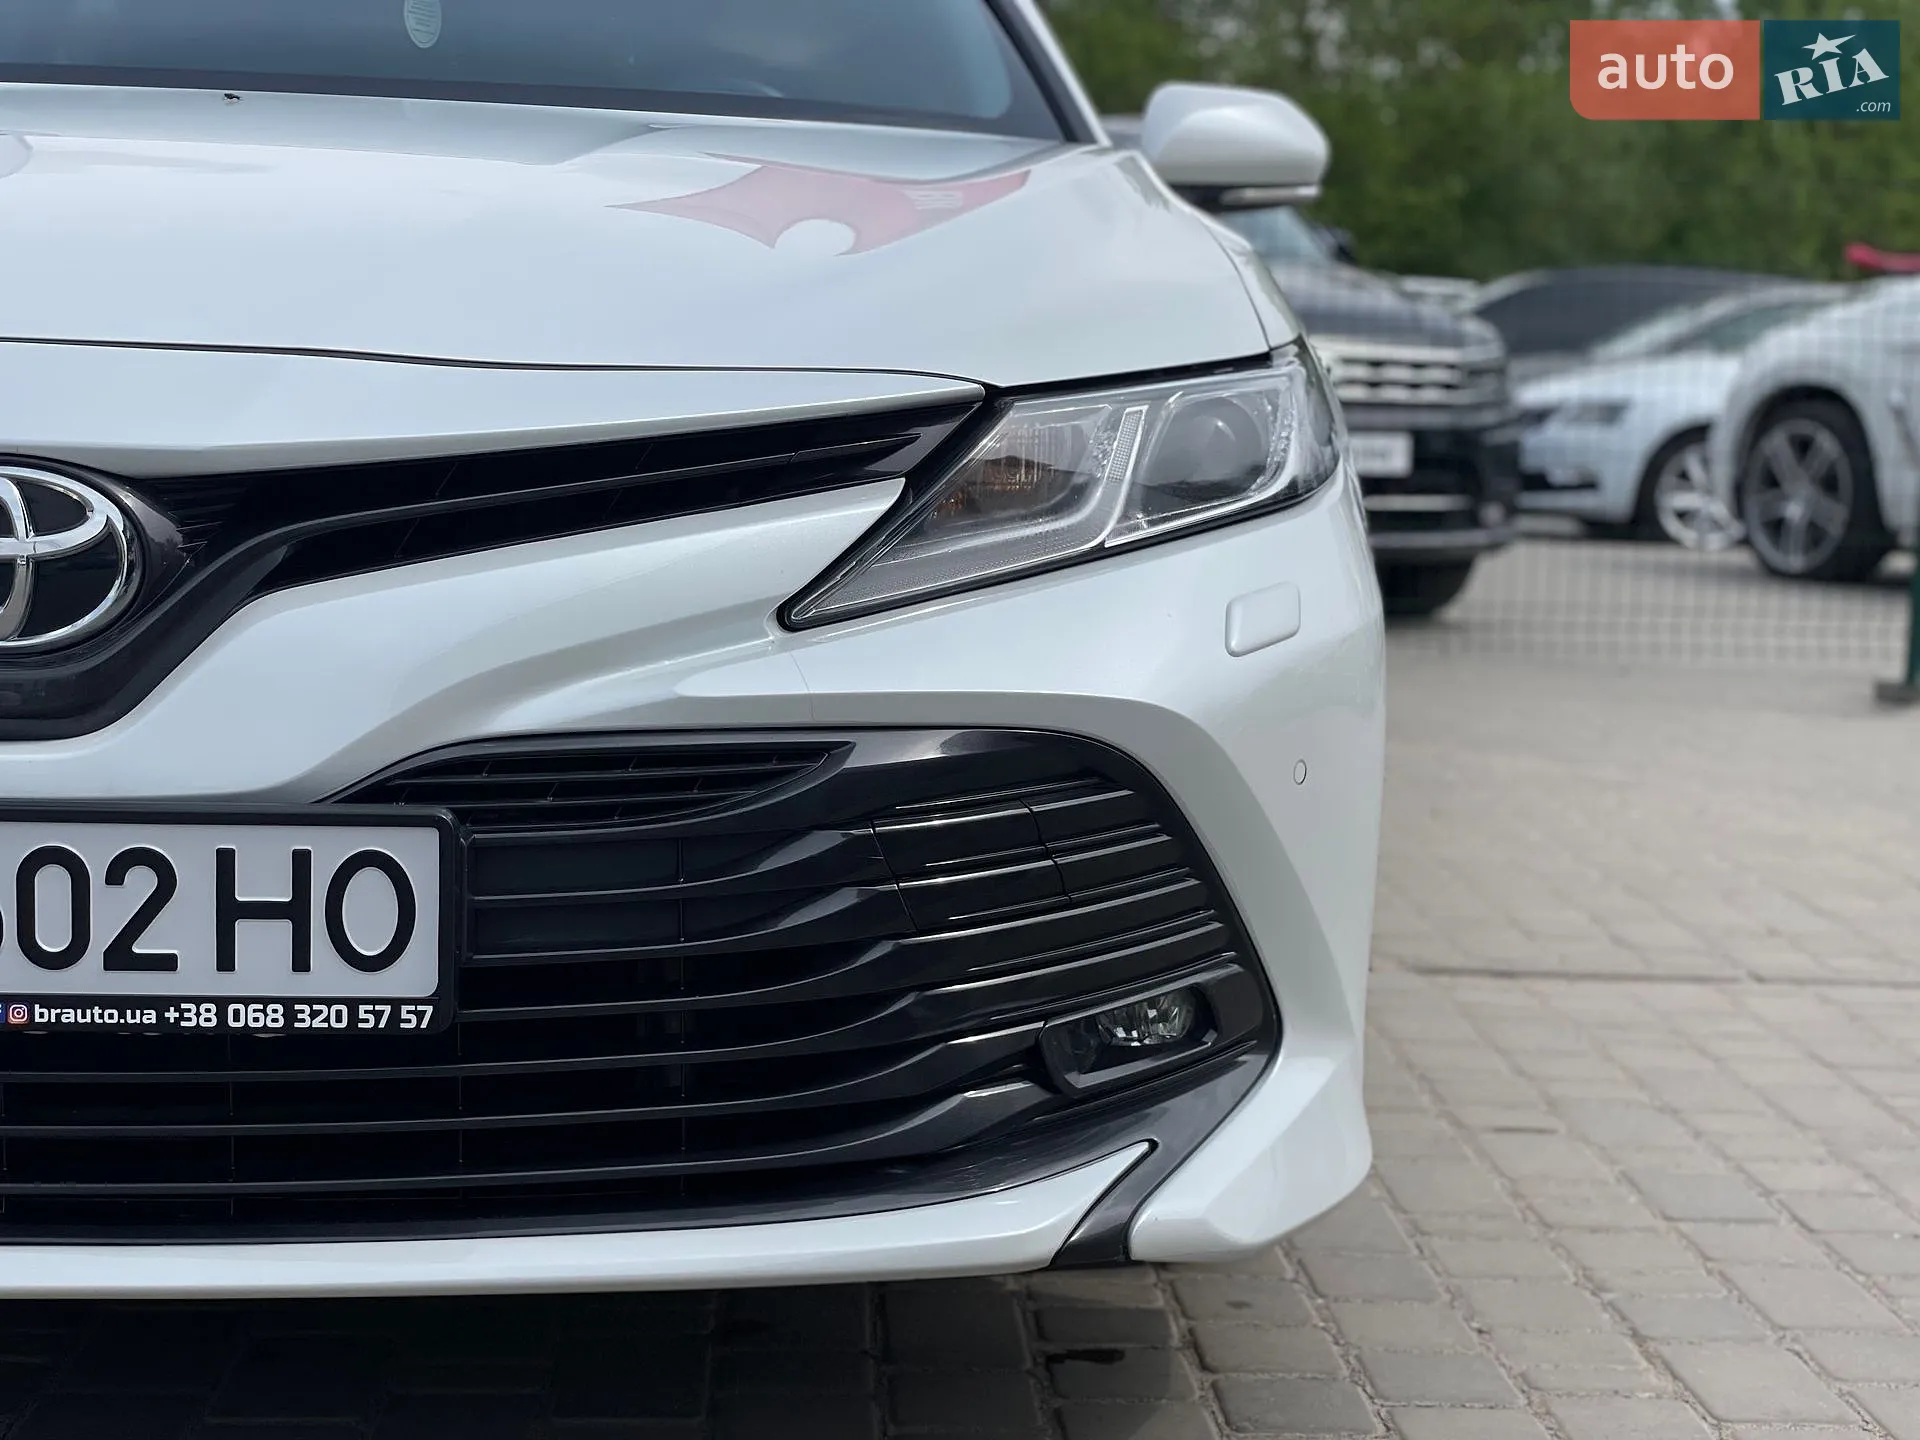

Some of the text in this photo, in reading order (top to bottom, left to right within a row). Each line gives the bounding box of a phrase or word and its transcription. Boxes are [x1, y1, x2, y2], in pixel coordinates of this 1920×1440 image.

[0, 845, 417, 973] 02 HO
[34, 1003, 434, 1029] brauto.ua +38 068 320 57 57
